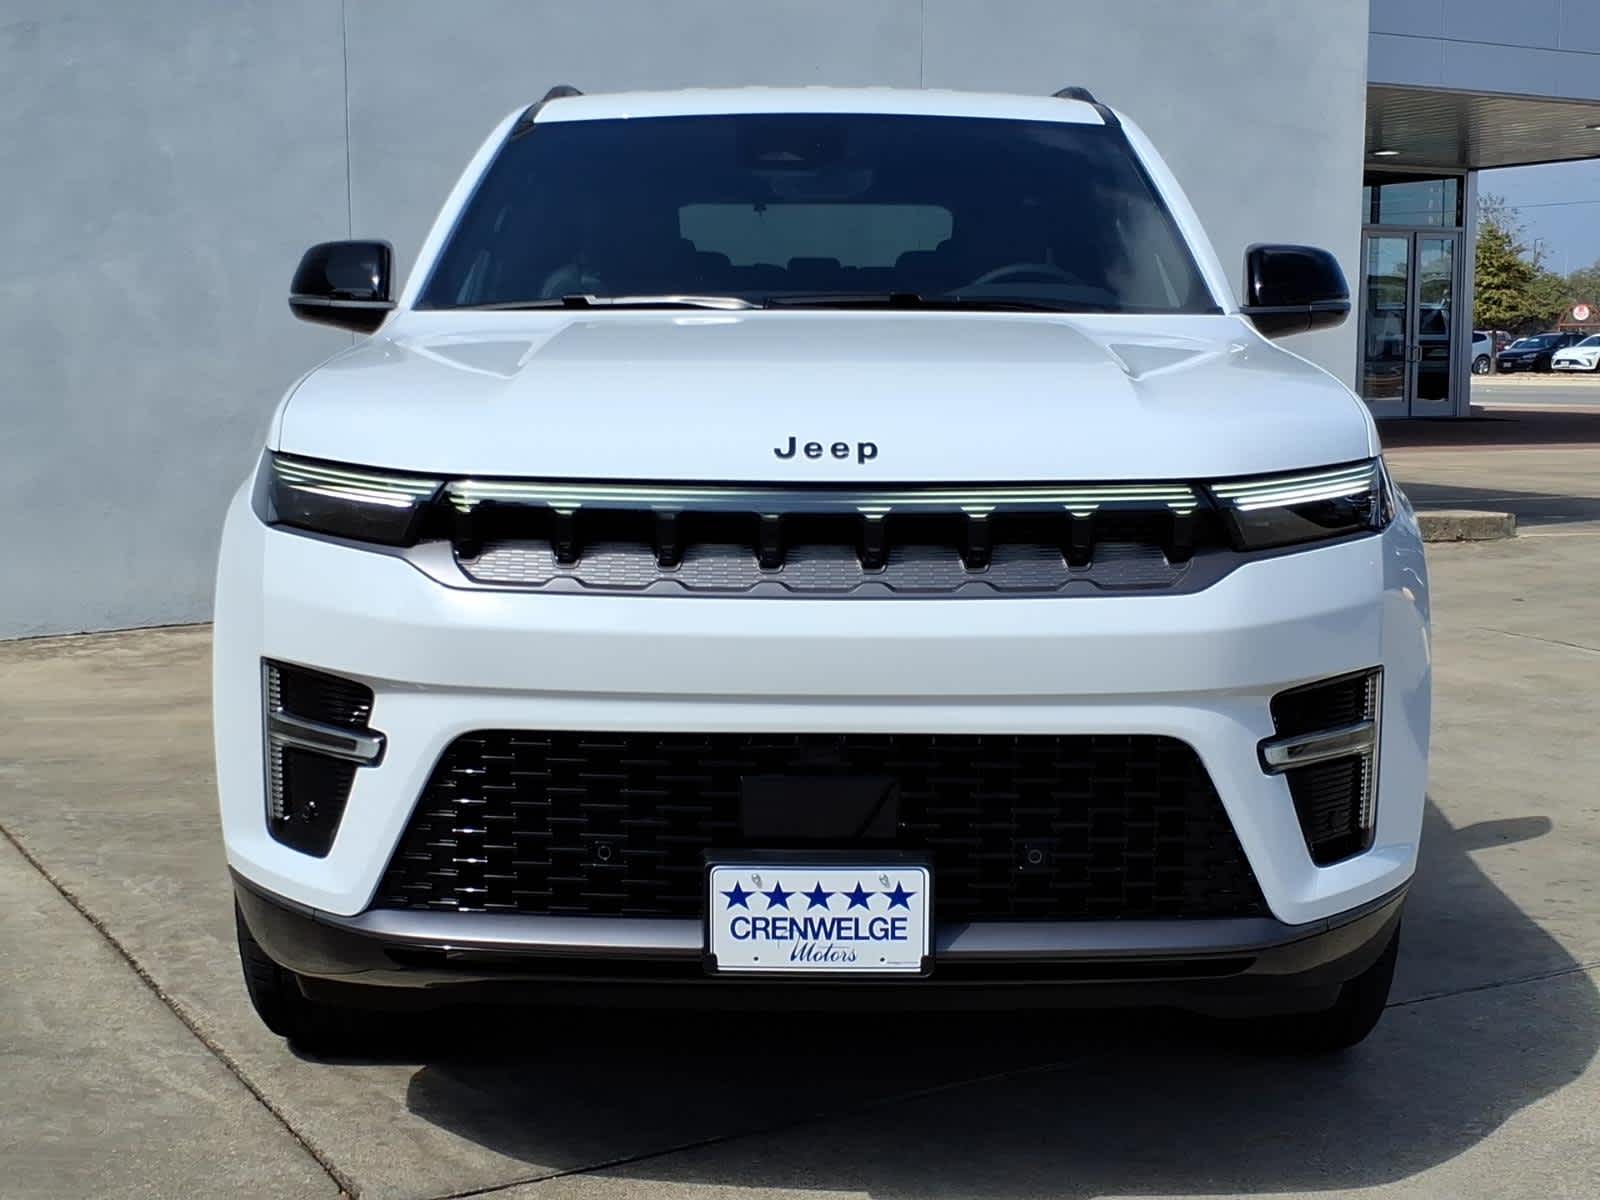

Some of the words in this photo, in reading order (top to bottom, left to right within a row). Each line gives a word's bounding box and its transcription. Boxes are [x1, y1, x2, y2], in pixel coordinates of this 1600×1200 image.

[773, 436, 878, 465] Jeep
[730, 916, 908, 941] CRENWELGE
[790, 939, 857, 963] Motors
